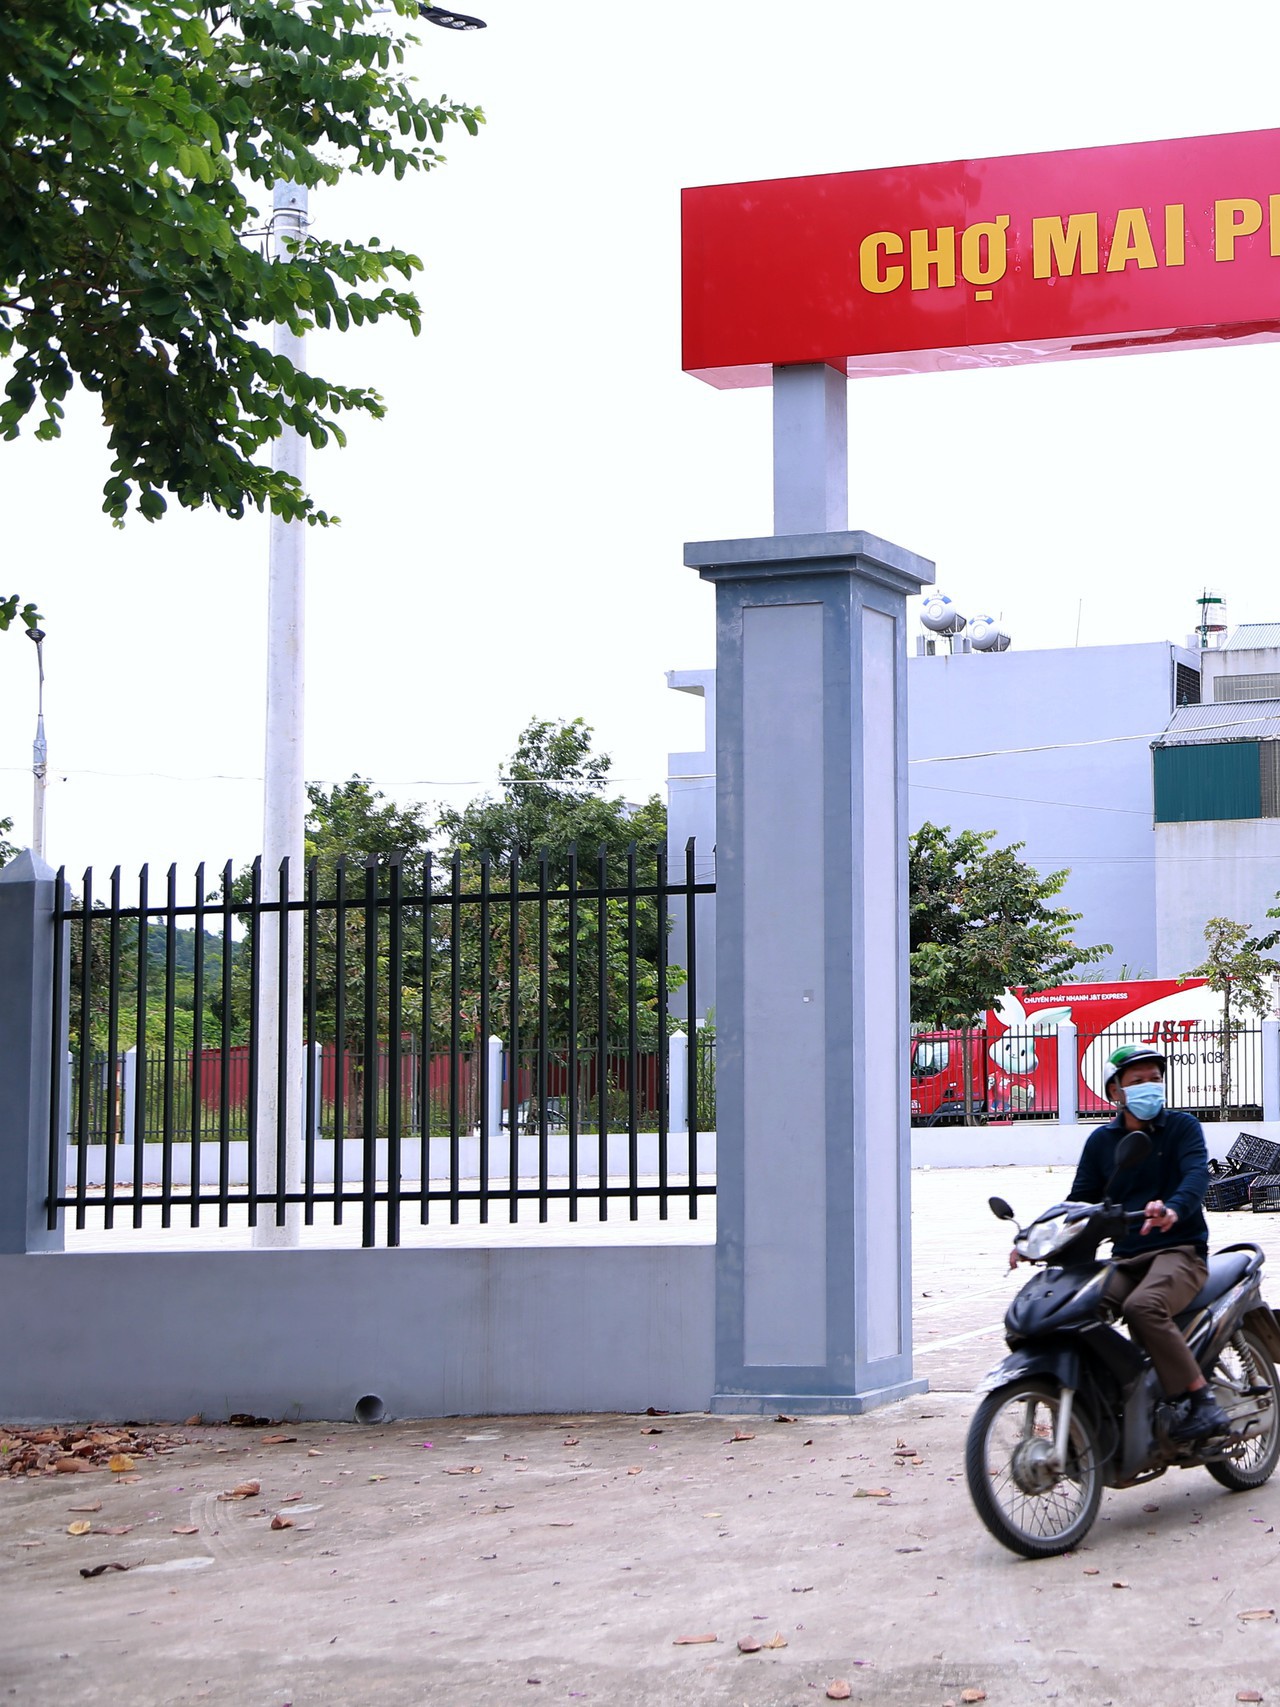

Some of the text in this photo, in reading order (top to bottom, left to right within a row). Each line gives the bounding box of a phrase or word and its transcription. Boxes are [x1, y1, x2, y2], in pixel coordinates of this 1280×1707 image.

[859, 214, 1010, 301] CHỢ
[1032, 204, 1185, 279] MAI
[1066, 994, 1088, 1002] NHANH
[1089, 993, 1101, 1001] J&T
[1101, 992, 1128, 1000] EXPRESS
[1142, 1019, 1198, 1043] J&T
[1167, 1051, 1224, 1066] 1900 108
